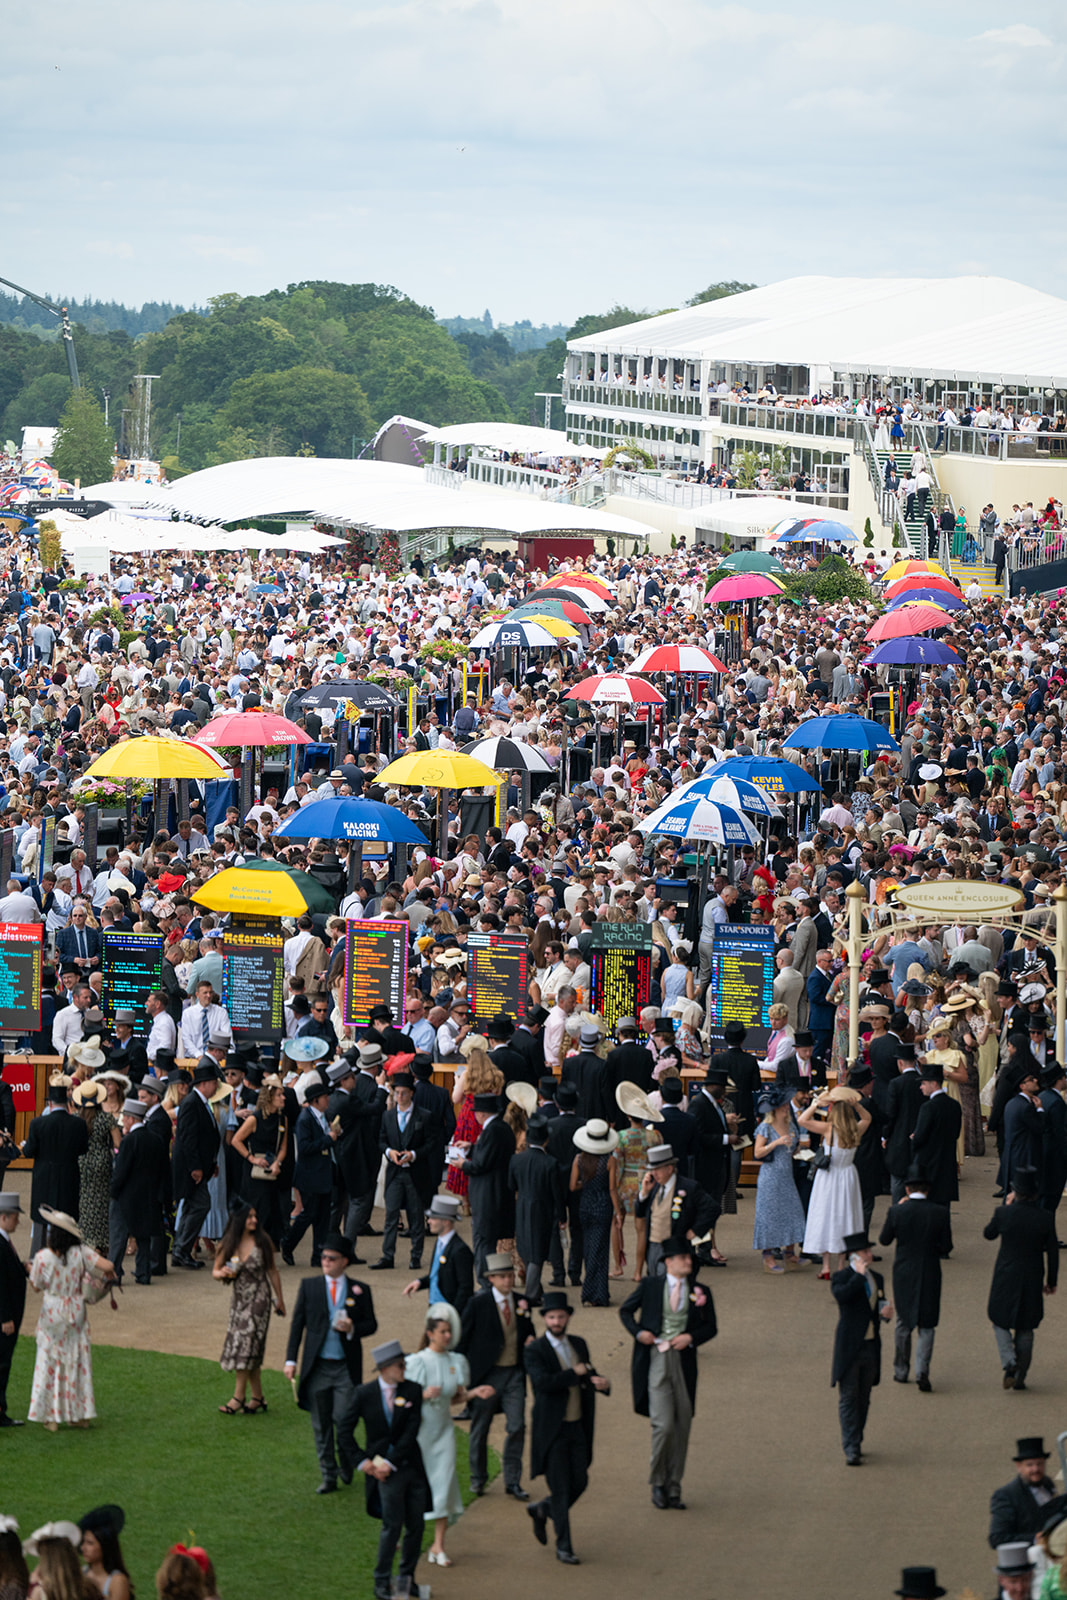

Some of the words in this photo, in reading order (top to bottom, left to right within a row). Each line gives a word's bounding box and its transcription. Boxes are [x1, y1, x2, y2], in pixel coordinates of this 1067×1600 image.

[747, 526, 765, 534] Silks
[501, 632, 521, 640] DS
[752, 776, 782, 784] KEVIN
[742, 795, 762, 804] SEAMUS
[743, 801, 767, 811] MULVANEY
[664, 816, 688, 824] SEAMUS
[343, 822, 380, 831] KALOOKI
[657, 822, 687, 832] MULVANEY
[724, 822, 742, 831] SEAMUS
[346, 829, 378, 838] RACING
[725, 831, 747, 840] MULVANEY
[231, 886, 272, 895] McCormack
[229, 893, 271, 903] Bookmaking
[719, 925, 738, 934] STAR
[740, 926, 770, 935] SPORTS
[0, 932, 38, 942] dlestone
[223, 932, 284, 946] McCormack
[603, 932, 642, 944] RACING
[9, 1083, 31, 1092] one
